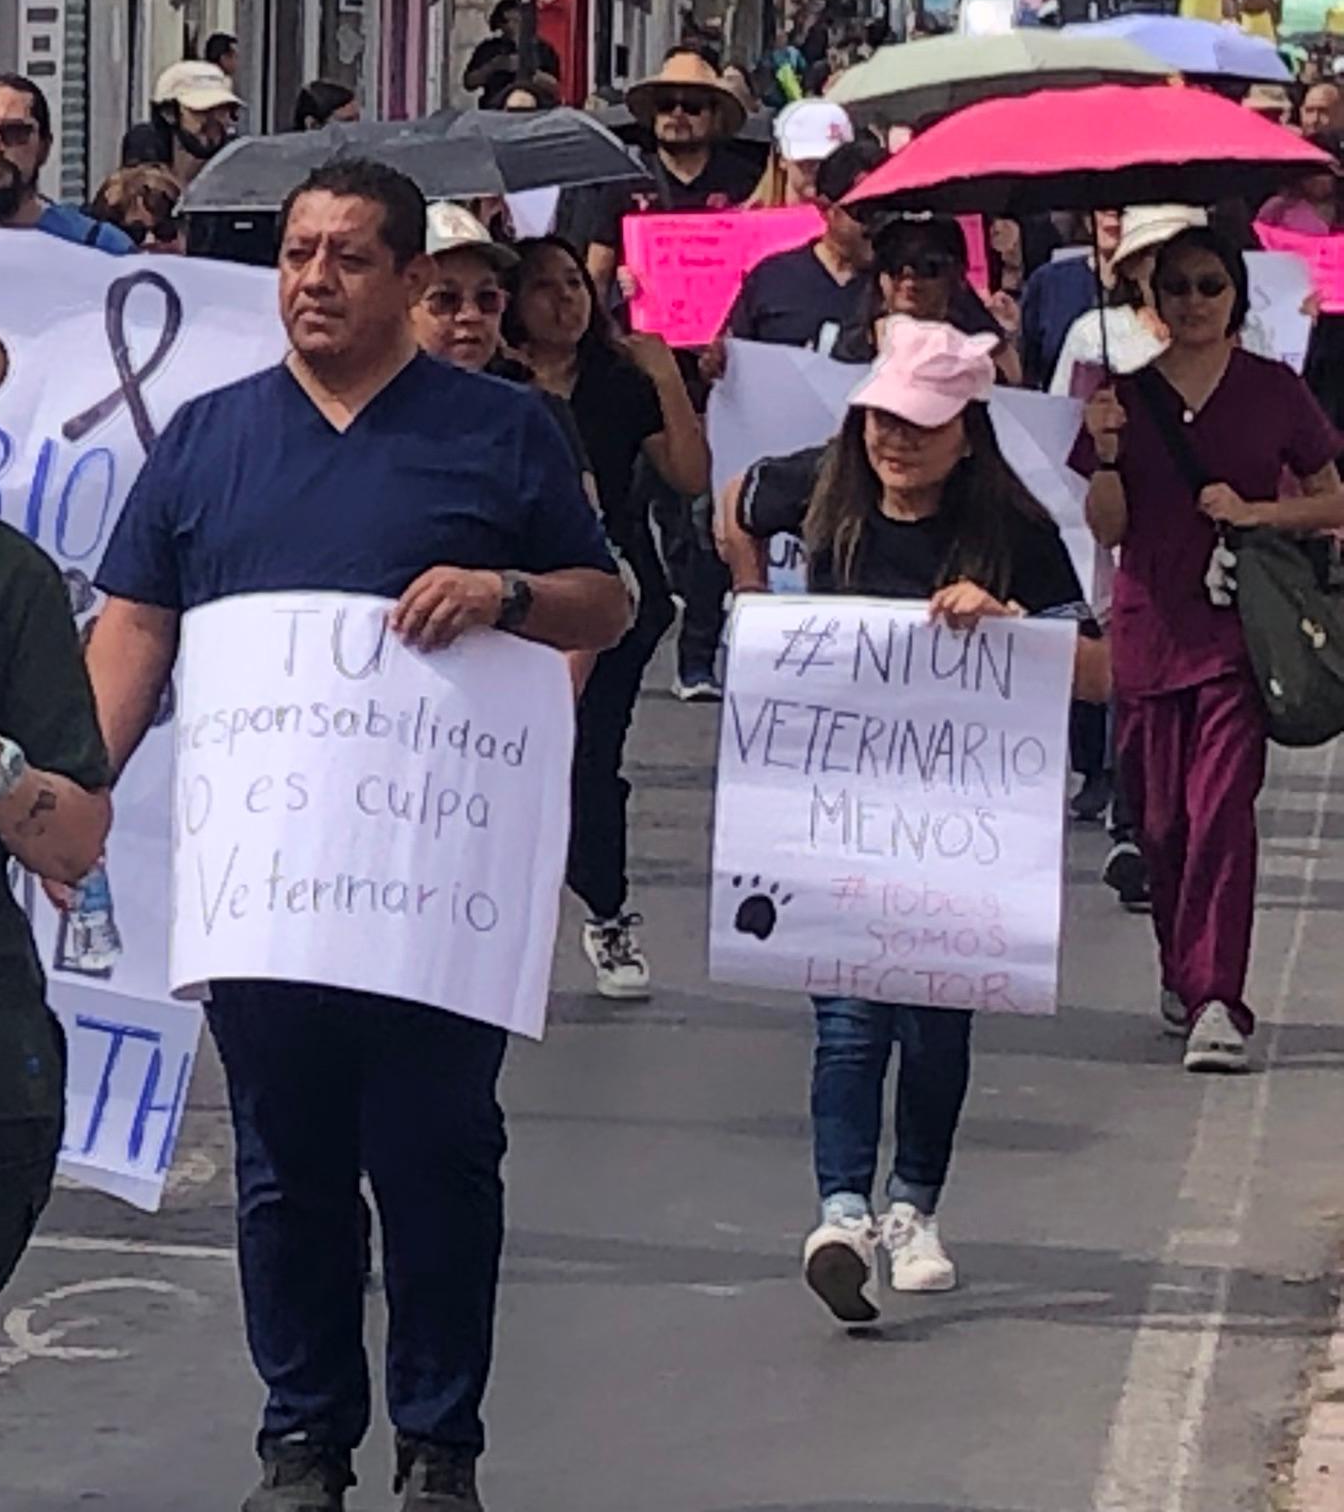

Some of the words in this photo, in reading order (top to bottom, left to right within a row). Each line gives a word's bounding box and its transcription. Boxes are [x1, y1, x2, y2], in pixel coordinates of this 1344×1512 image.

[274, 608, 392, 681] TU
[729, 691, 1047, 798] VETERINARIO
[245, 771, 309, 815] es
[355, 771, 491, 840] culpa
[810, 783, 1002, 865] MENOS
[864, 921, 1008, 966] SOMOS
